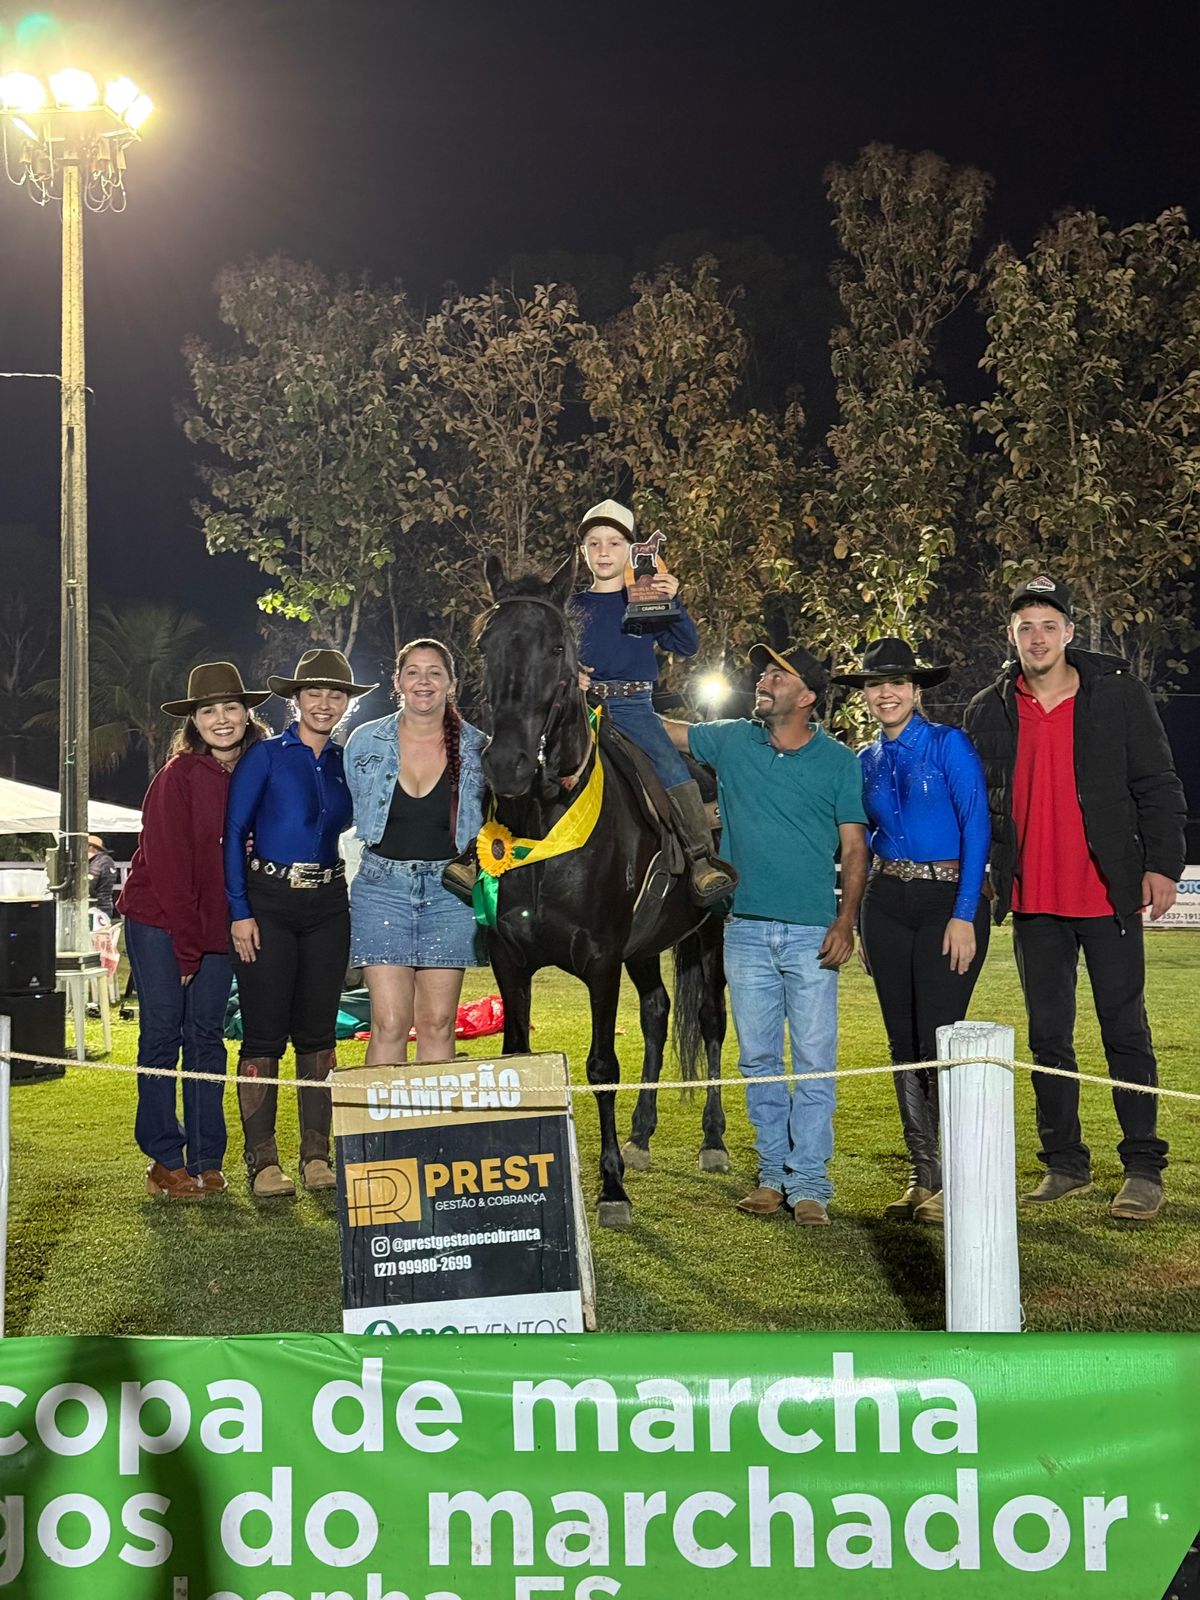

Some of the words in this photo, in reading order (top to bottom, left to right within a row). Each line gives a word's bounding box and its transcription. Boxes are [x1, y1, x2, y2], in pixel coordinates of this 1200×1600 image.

[367, 1064, 521, 1121] CAMPEÃO
[424, 1153, 555, 1197] PREST
[435, 1197, 476, 1211] GESTÃO
[478, 1198, 486, 1208] &
[487, 1192, 547, 1205] COBRANÇA
[392, 1228, 541, 1253] @prestgestaoecobranca
[374, 1261, 396, 1278] (27)
[398, 1255, 472, 1275] 99980-2699
[313, 1358, 463, 1453] de
[512, 1352, 979, 1454] marcha
[221, 1467, 379, 1567] do
[429, 1466, 1128, 1572] marchador
